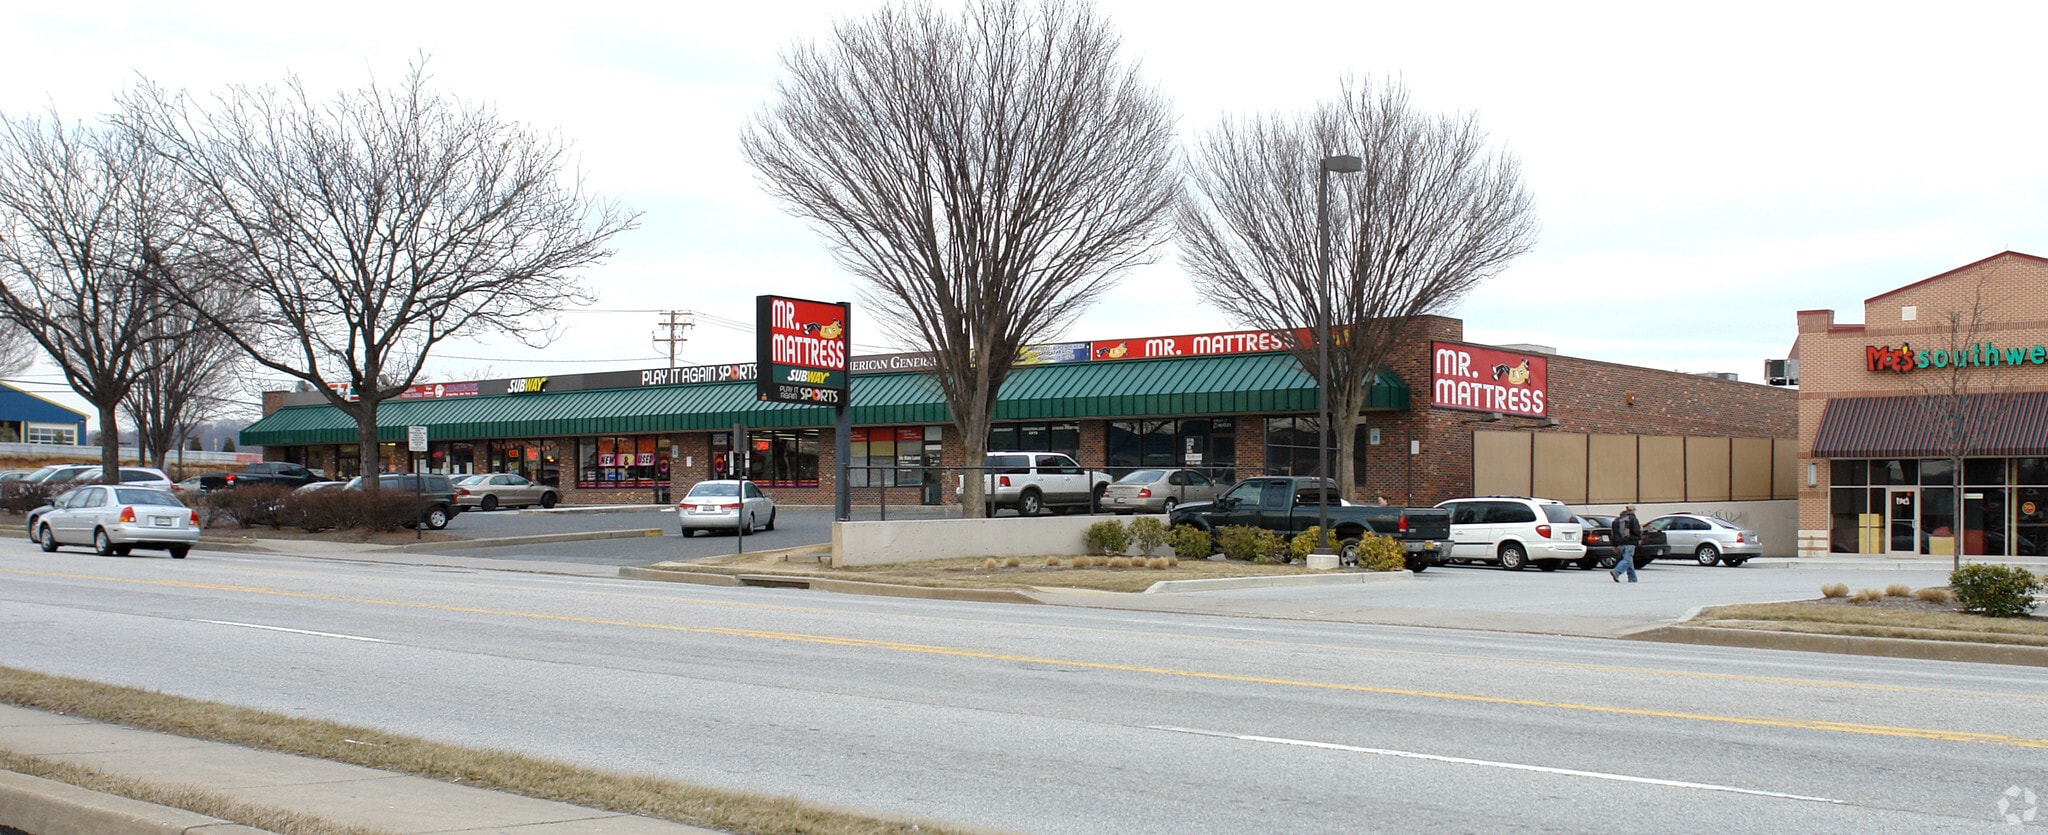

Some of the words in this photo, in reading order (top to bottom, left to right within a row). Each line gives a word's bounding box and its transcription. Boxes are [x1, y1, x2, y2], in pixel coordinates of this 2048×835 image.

[772, 299, 800, 331] MR.
[772, 333, 845, 369] MATTRESS
[1145, 338, 1182, 357] MR.
[1193, 331, 1295, 355] MATTRESS
[1436, 348, 1479, 379] MR.
[642, 369, 668, 386] PLAY
[670, 368, 681, 384] IT
[682, 366, 716, 383] AGAIN
[718, 363, 758, 381] SPORTS
[787, 369, 830, 384] SUBWAY
[507, 377, 547, 393] SUBWAY
[780, 385, 794, 393] PLAY
[780, 391, 798, 400] AGAIN
[800, 387, 838, 403] SPORTS
[1435, 378, 1544, 413] MATTRESS
[601, 455, 616, 465] NEW
